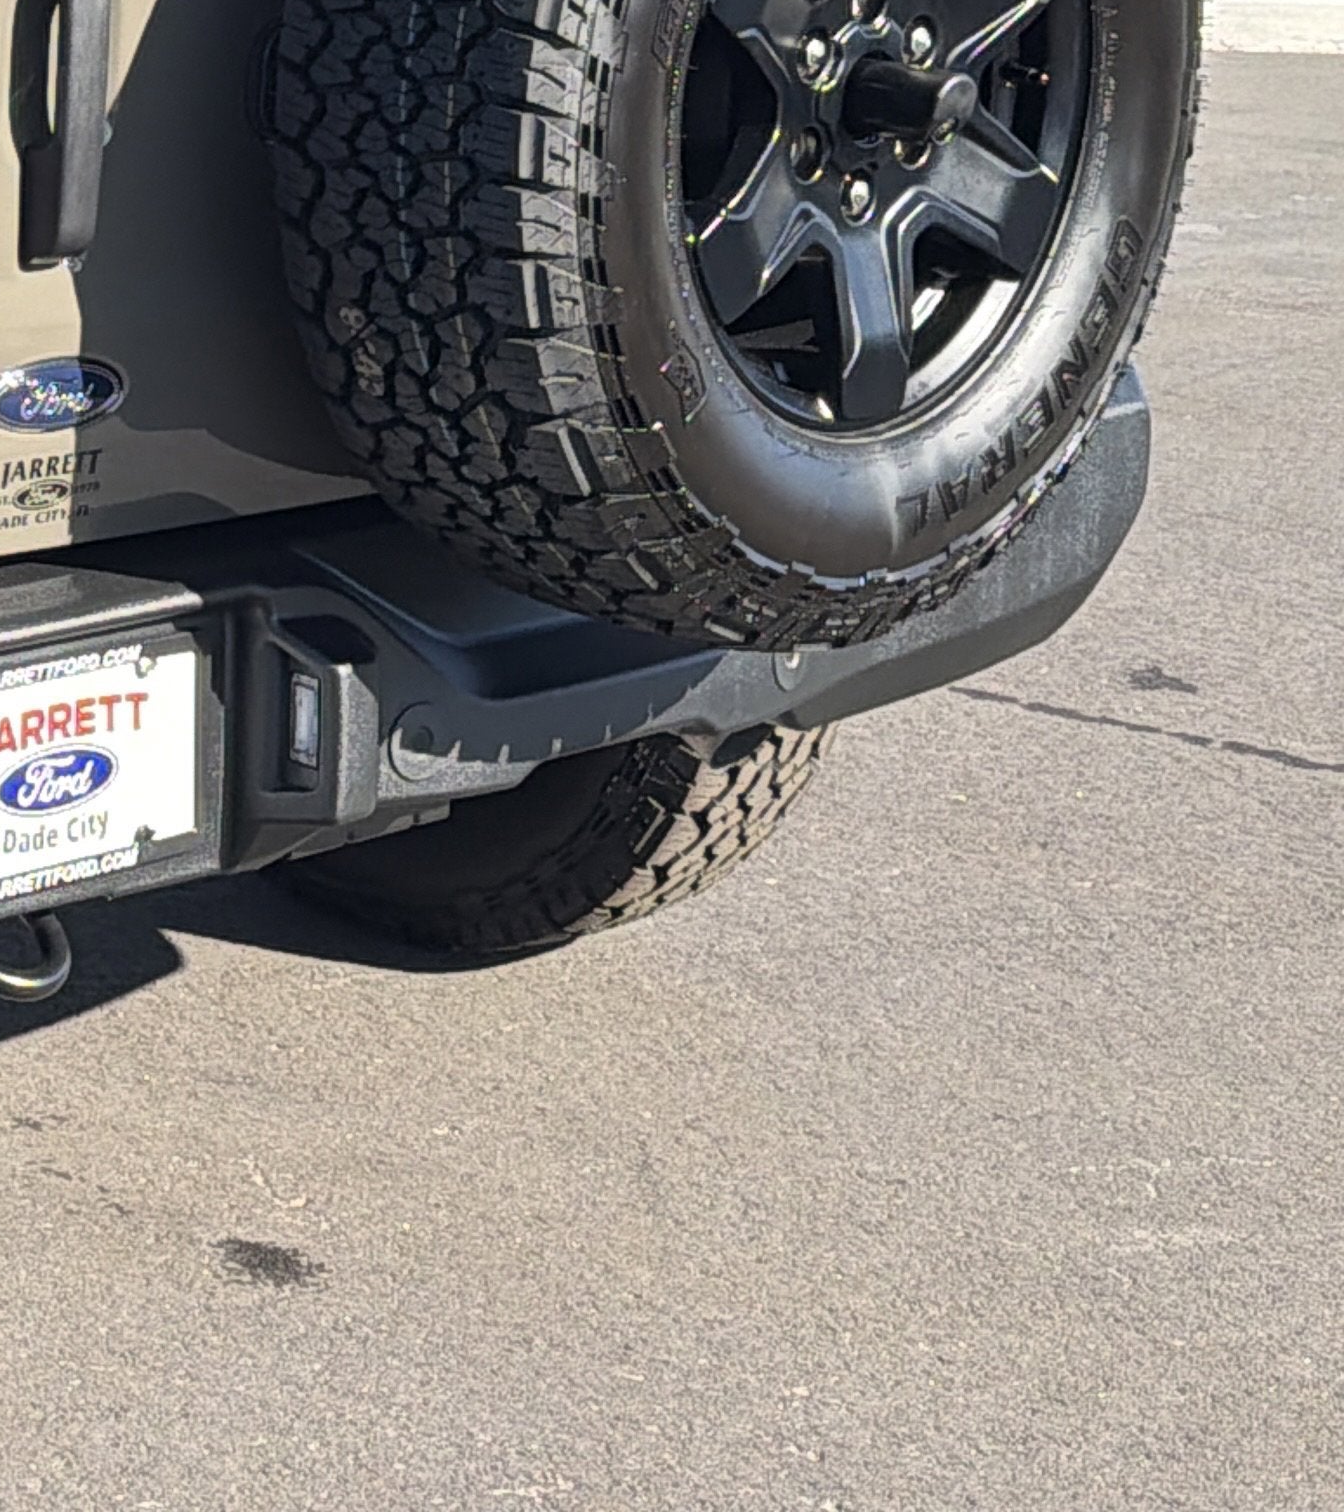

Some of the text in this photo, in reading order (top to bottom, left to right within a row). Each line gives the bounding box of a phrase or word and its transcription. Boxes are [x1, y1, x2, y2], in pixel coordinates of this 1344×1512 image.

[20, 378, 94, 420] Ford
[896, 215, 1143, 535] GENERAL
[16, 754, 95, 808] Ford
[2, 810, 109, 854] Dade City
